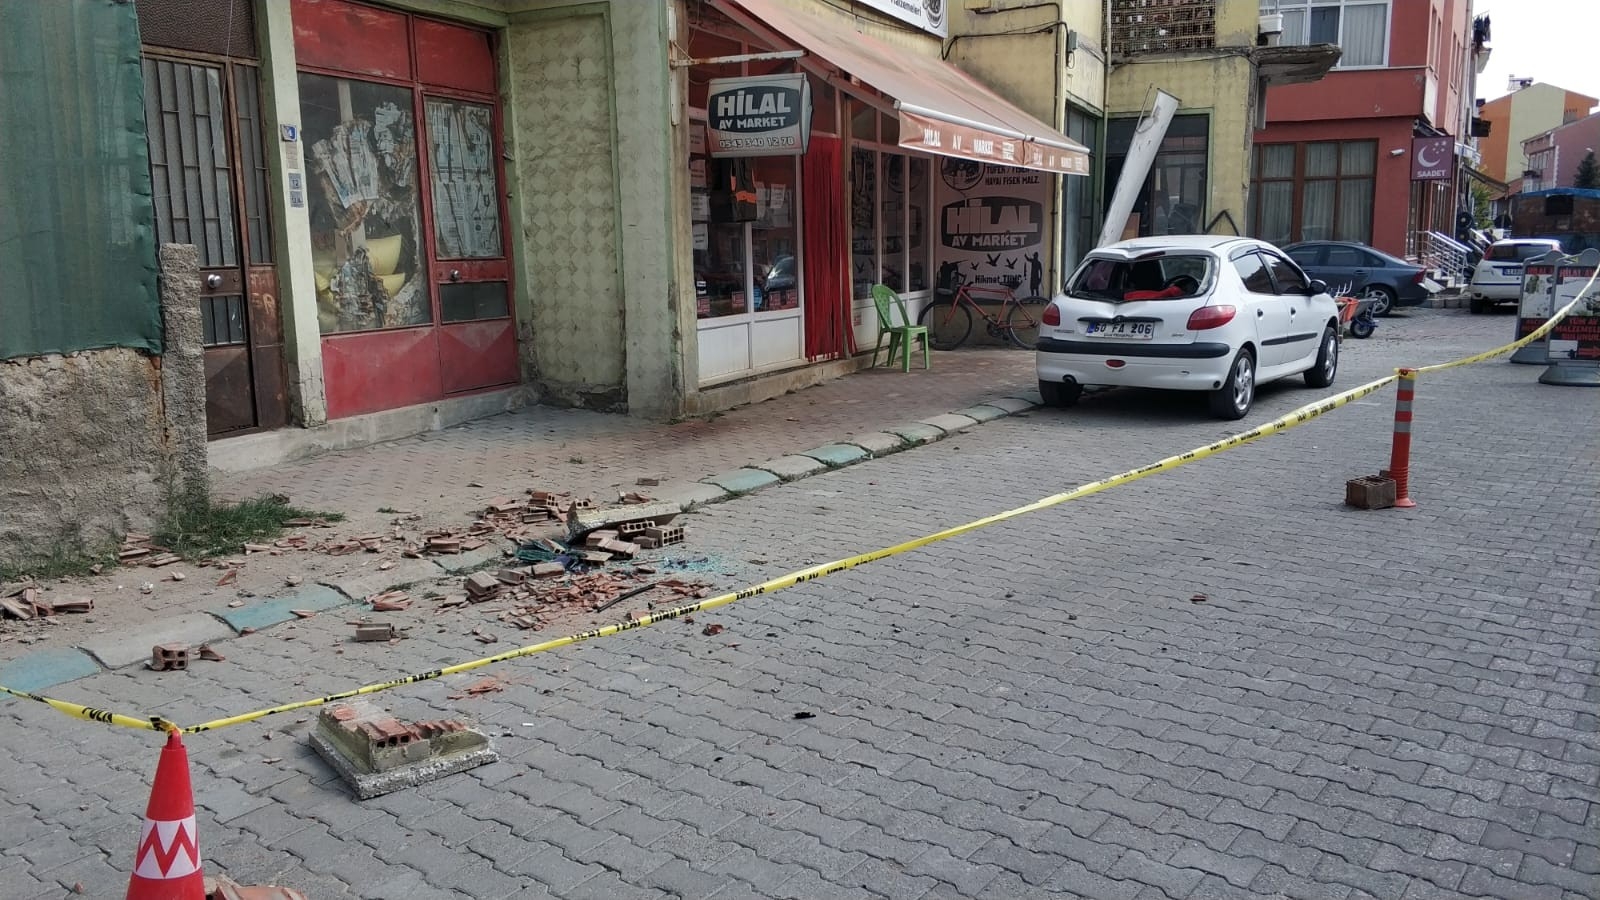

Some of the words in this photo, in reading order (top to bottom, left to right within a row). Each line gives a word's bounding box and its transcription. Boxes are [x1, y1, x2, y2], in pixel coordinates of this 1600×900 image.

[718, 90, 791, 117] HİLAL
[719, 119, 733, 129] AV
[737, 117, 786, 128] MARKET
[767, 138, 779, 146] 12
[952, 135, 962, 150] AV
[1417, 169, 1447, 178] SAADET
[947, 198, 1038, 234] HİLAL
[952, 236, 967, 247] AV
[972, 234, 1027, 247] MARKET
[1111, 323, 1125, 333] FA
[1131, 323, 1152, 334] 206
